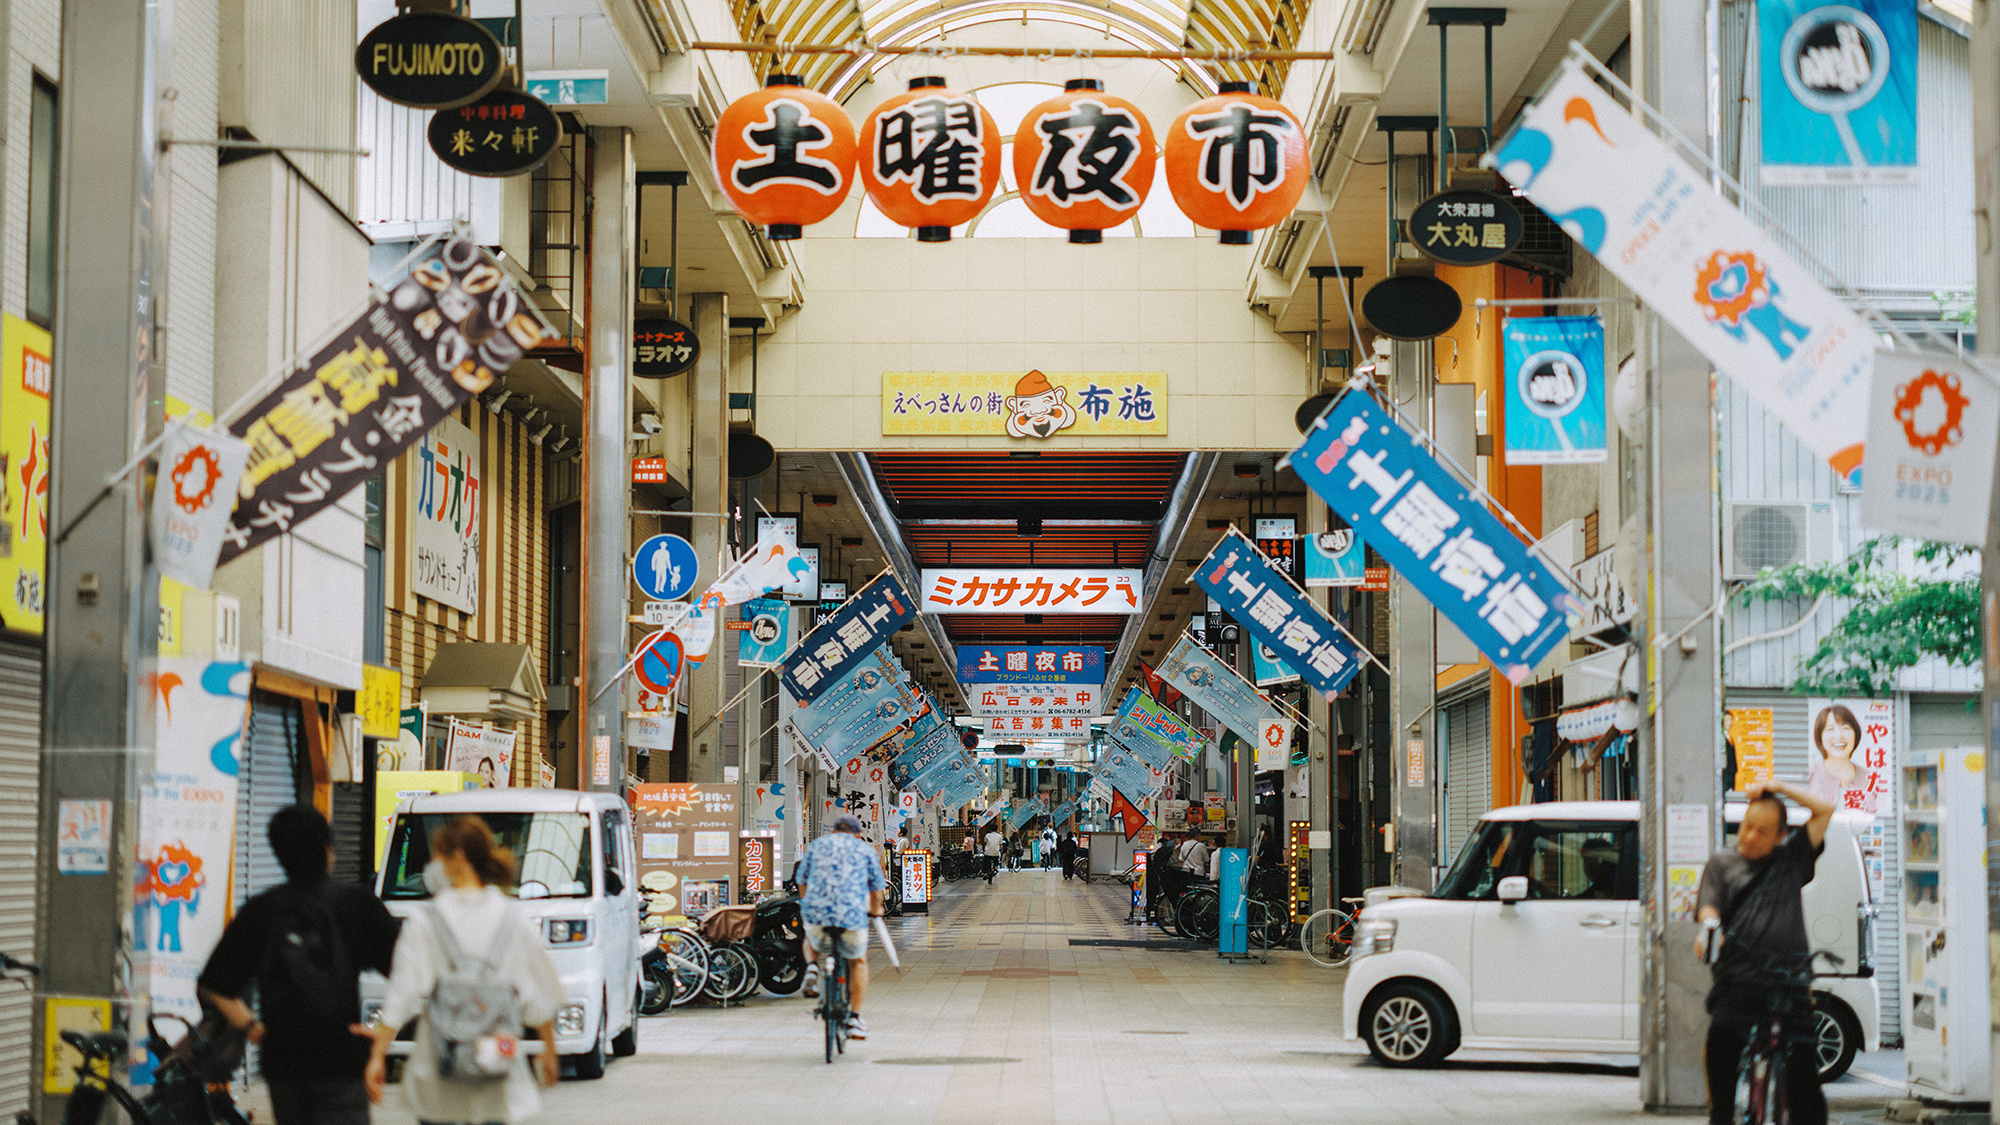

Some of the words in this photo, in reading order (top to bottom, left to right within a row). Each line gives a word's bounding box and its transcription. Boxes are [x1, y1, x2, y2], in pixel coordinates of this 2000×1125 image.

[373, 43, 484, 75] FUJIMOTO
[451, 127, 539, 157] 来々軒
[735, 93, 1306, 216] 土曜夜市
[1438, 202, 1495, 217] 大衆酒場
[1427, 221, 1506, 248] 大丸屋
[893, 391, 1004, 415] えべっさんの街
[1077, 384, 1156, 422] 布施
[419, 433, 478, 539] カラオケ
[418, 545, 464, 599] サウンドキューブ
[928, 576, 1110, 607] ミカサカメラ
[792, 602, 891, 691] 土曜夜市
[977, 650, 1084, 673] 土曜夜市
[456, 728, 482, 740] DAM
[638, 720, 661, 729] EXPO
[638, 727, 660, 736] 2025
[1865, 723, 1888, 793] やはた
[182, 788, 225, 803] EXPO
[745, 838, 765, 892] カラオ
[913, 862, 923, 892] 串カツ
